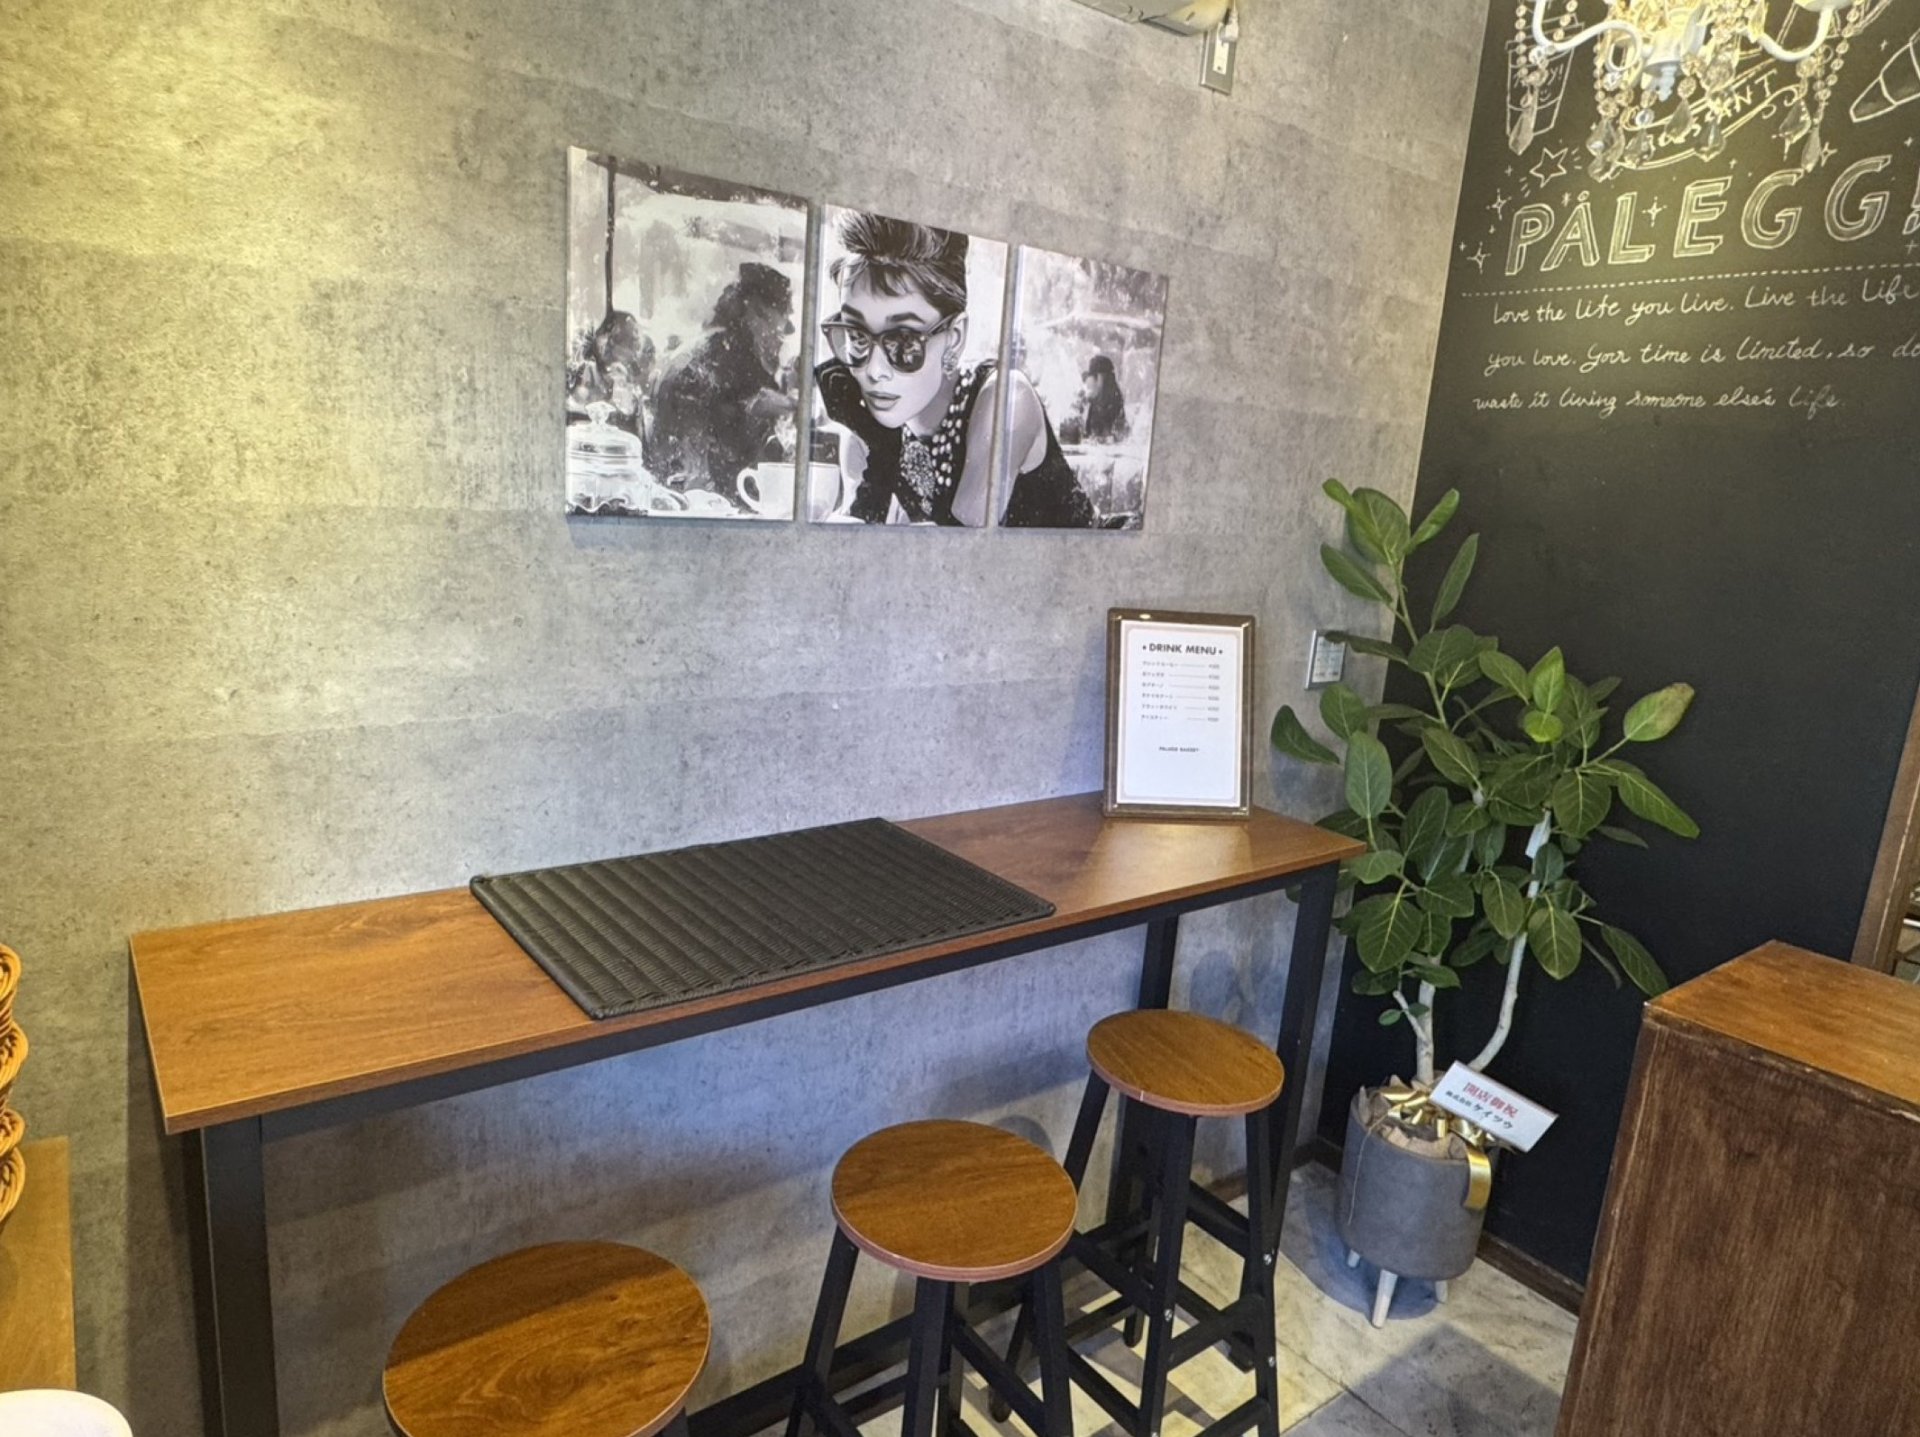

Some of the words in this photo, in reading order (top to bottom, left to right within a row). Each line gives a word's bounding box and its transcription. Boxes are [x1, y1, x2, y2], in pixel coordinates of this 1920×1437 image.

[1536, 301, 1567, 323] the
[1624, 301, 1674, 326] you
[1806, 285, 1848, 307] the
[1484, 352, 1526, 377] you
[1640, 344, 1692, 364] time
[1700, 343, 1727, 363] is
[1837, 342, 1875, 359] so
[1472, 392, 1523, 411] waste
[1527, 391, 1550, 409] it
[1558, 386, 1617, 419] living
[1625, 389, 1706, 409] someone
[1148, 642, 1183, 654] DRINK
[1185, 645, 1217, 656] MENU
